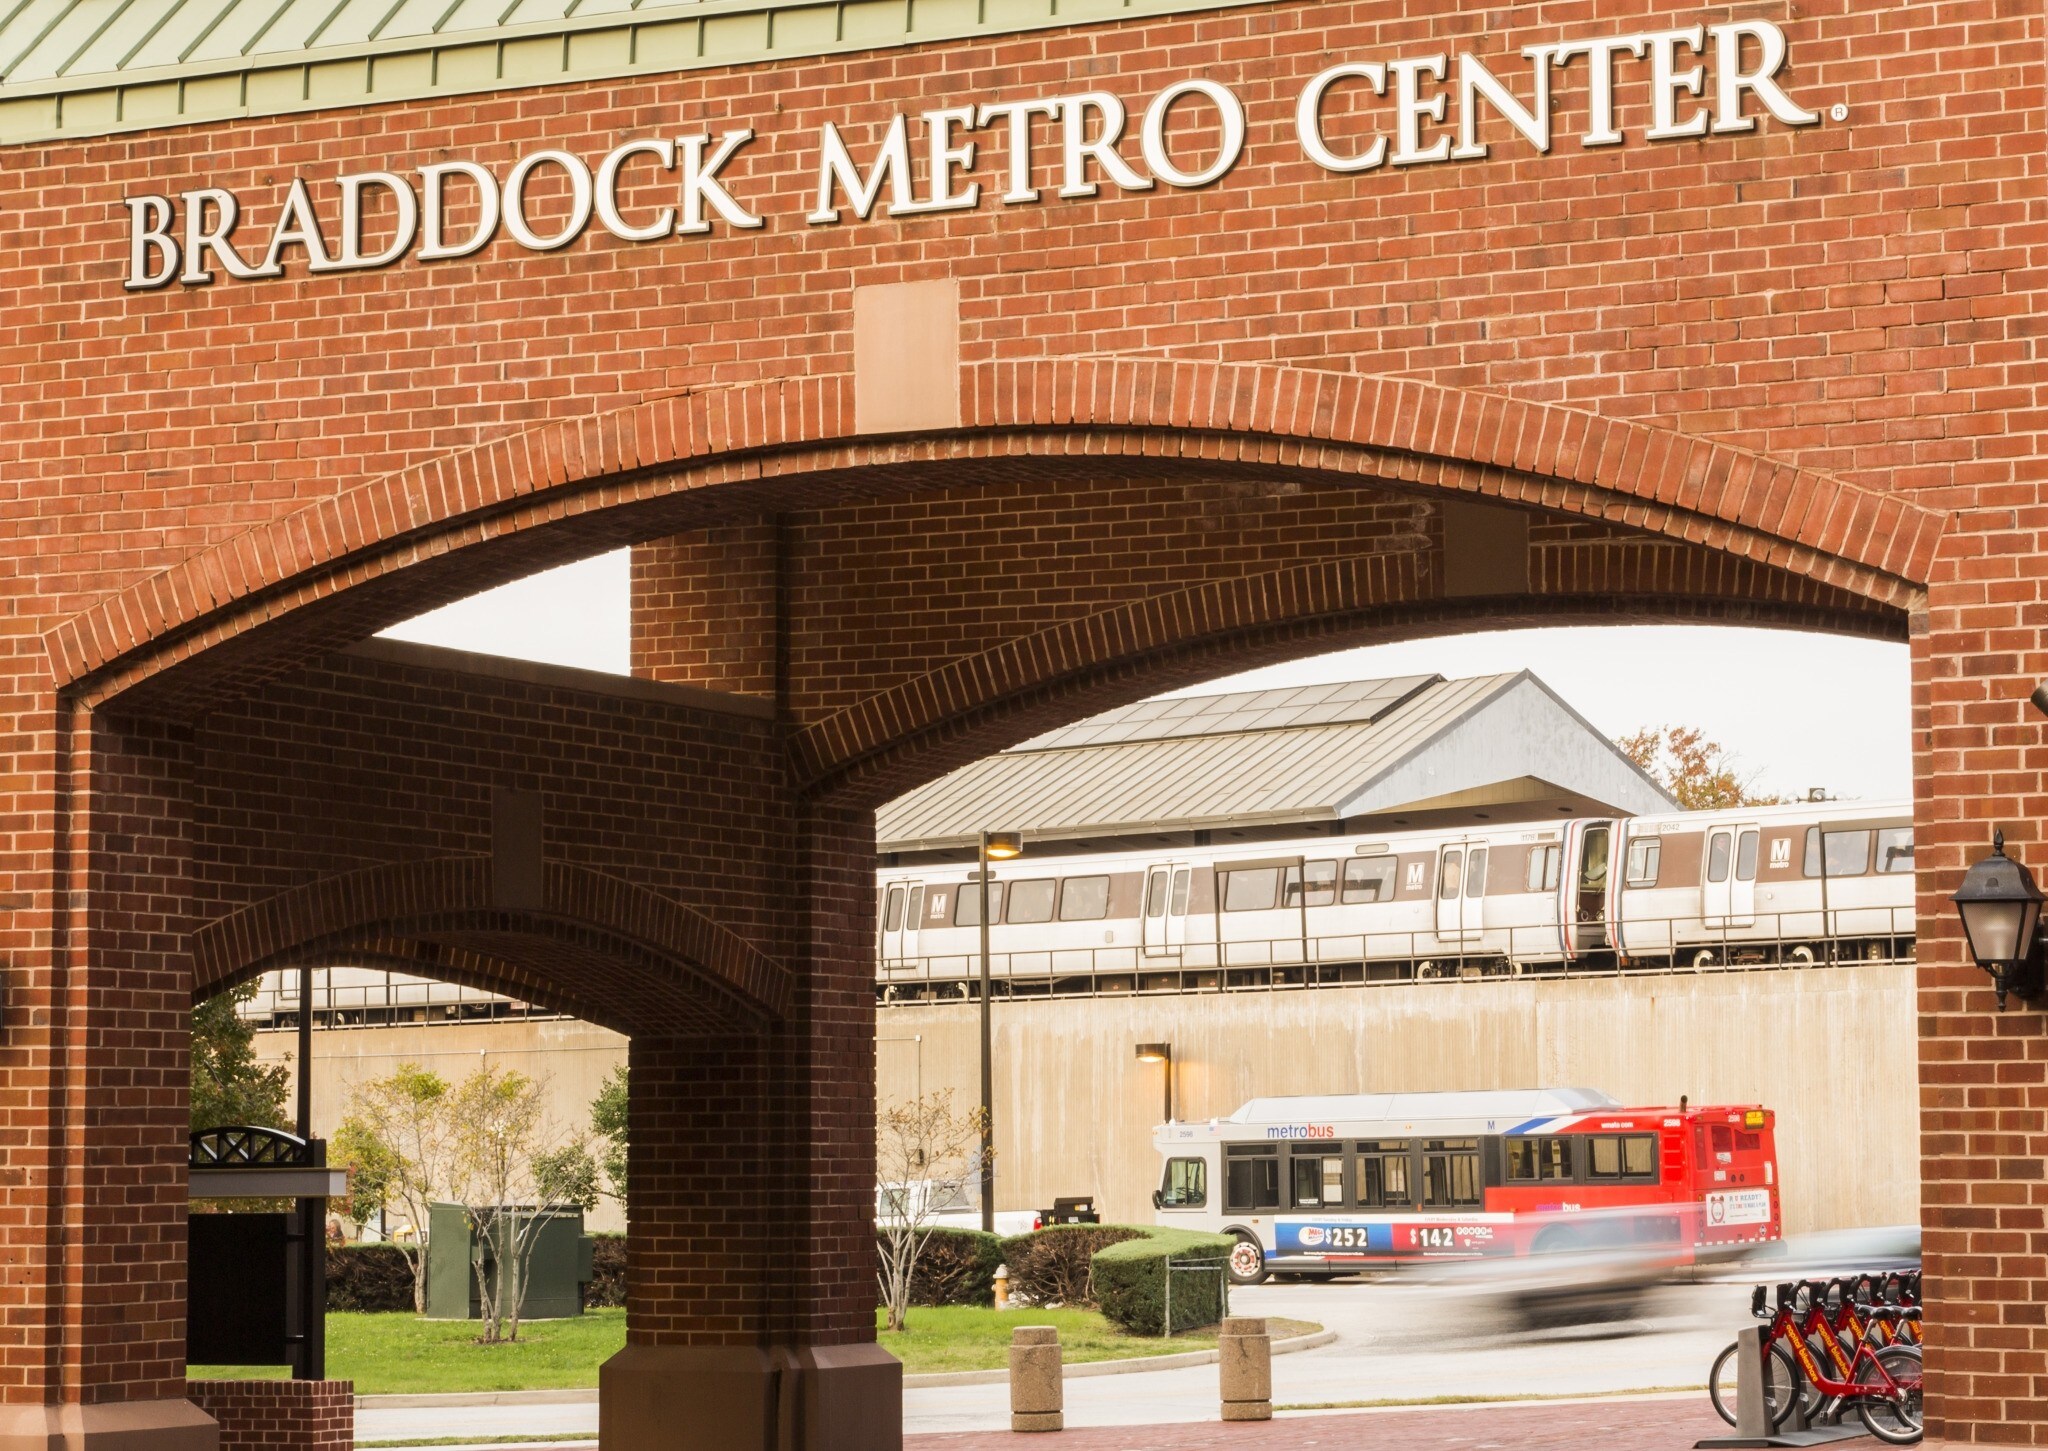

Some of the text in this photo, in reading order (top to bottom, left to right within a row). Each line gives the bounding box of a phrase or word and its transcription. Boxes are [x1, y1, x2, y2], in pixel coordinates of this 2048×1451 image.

[124, 127, 764, 291] BRADDOCK
[805, 77, 1246, 225] METRO
[1294, 17, 1820, 173] CENTER
[1663, 823, 1680, 832] 2042
[1769, 860, 1789, 870] metro
[1405, 883, 1423, 891] metro
[1267, 1123, 1335, 1139] metrobus
[1487, 1120, 1496, 1130] M
[1817, 1323, 1835, 1347] capital
[1786, 1324, 1818, 1382] capital bikeshare
